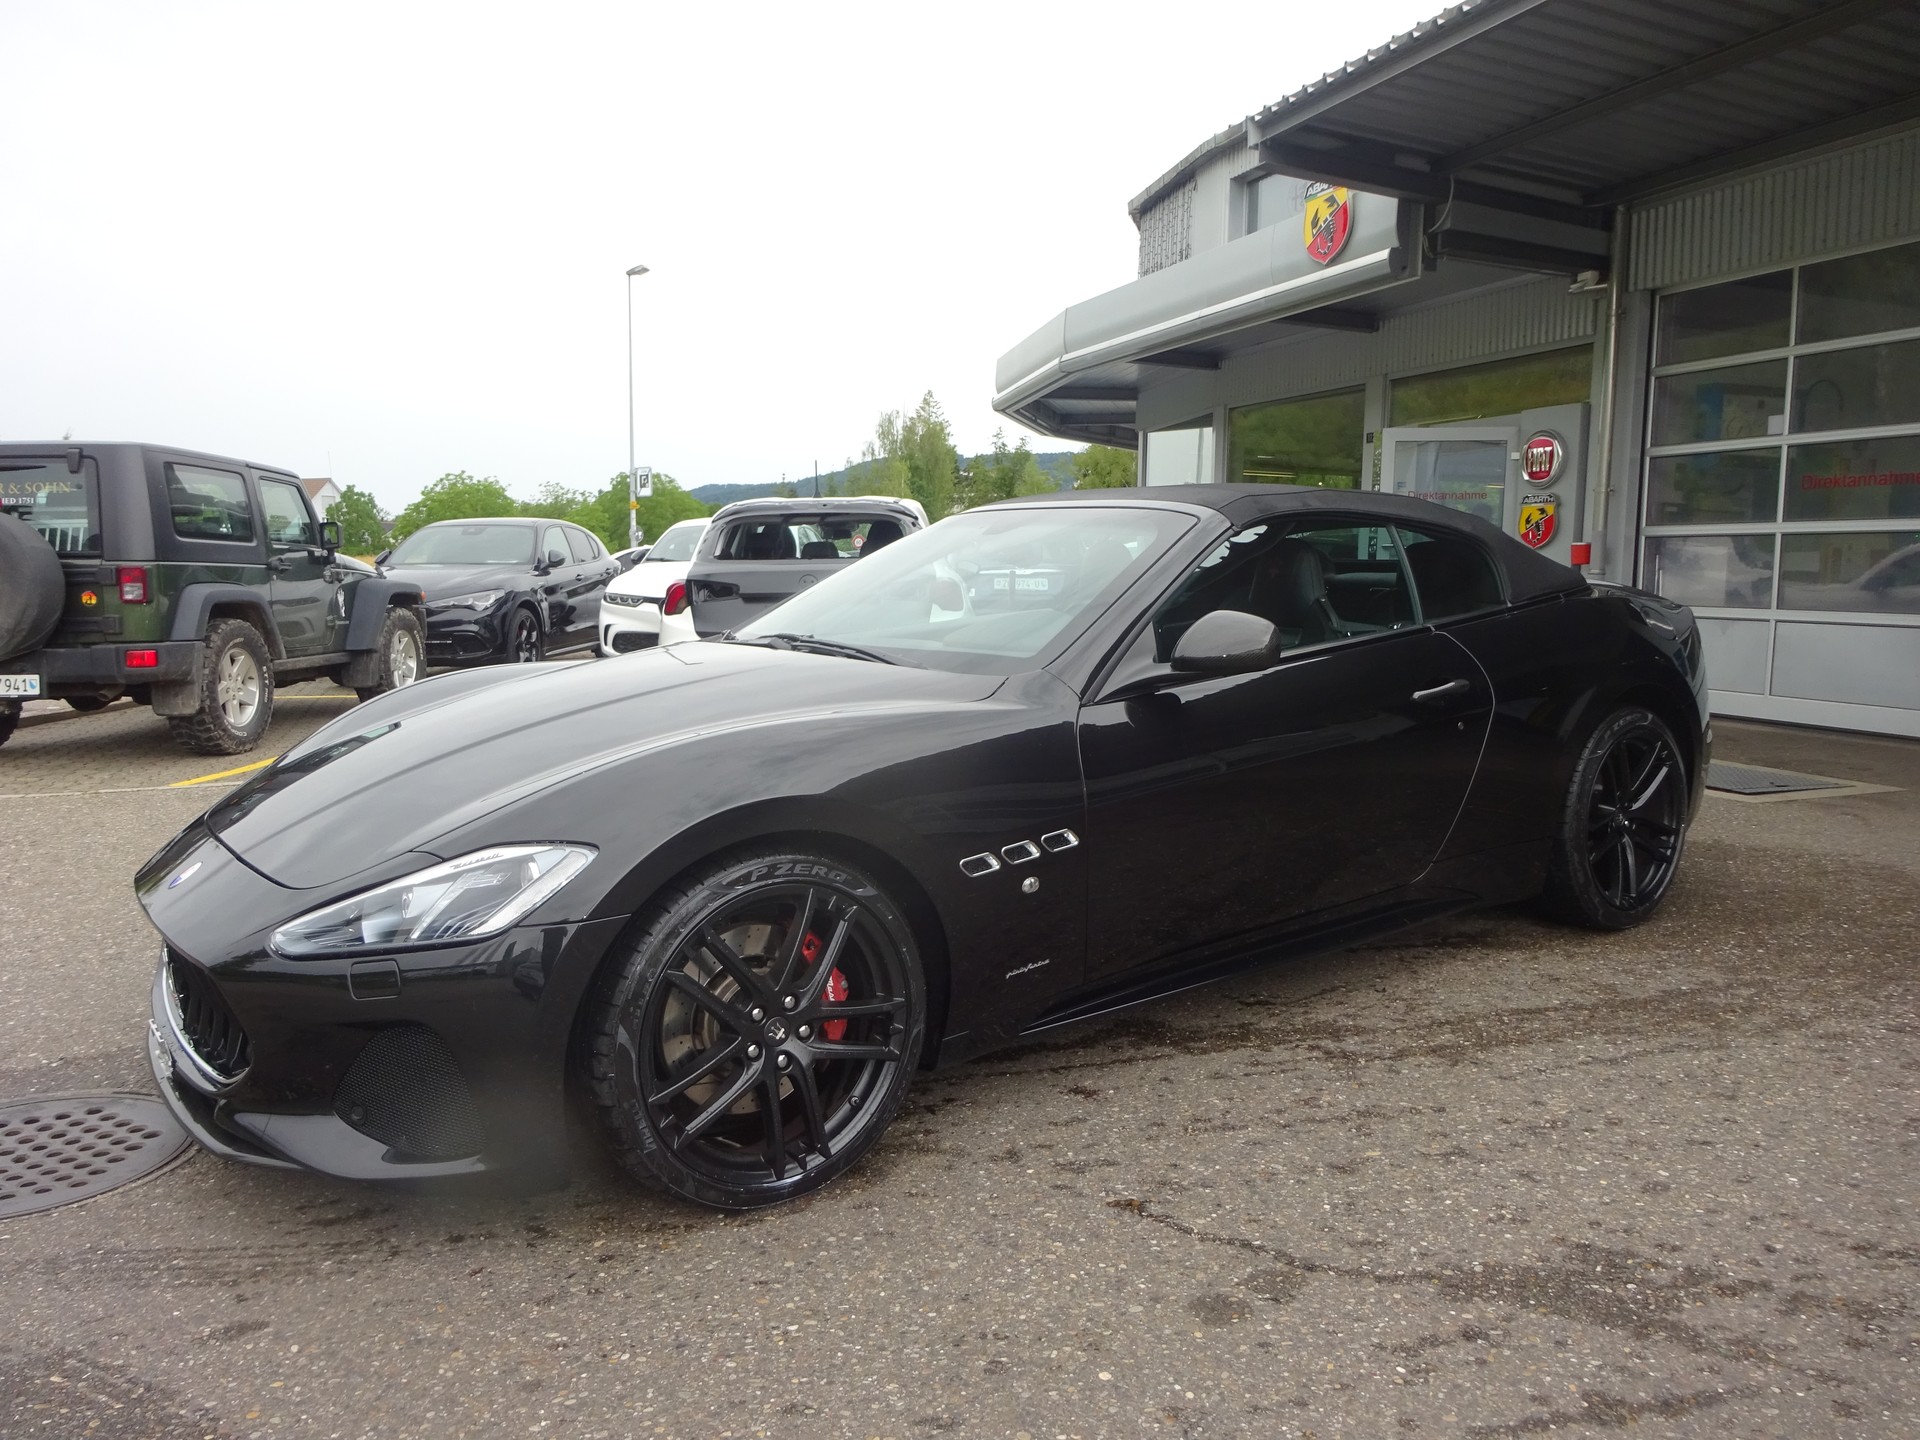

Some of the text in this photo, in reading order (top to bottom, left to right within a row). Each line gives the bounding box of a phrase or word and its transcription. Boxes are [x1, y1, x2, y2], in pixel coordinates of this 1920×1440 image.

[1527, 447, 1552, 473] FIAT
[8, 483, 20, 494] &
[24, 481, 71, 494] SOHN
[1800, 471, 1920, 490] Direktannahme
[1408, 490, 1487, 500] Direktannahme
[1523, 496, 1554, 504] ABARTH
[0, 678, 28, 692] 941
[750, 863, 847, 882] P ZERO
